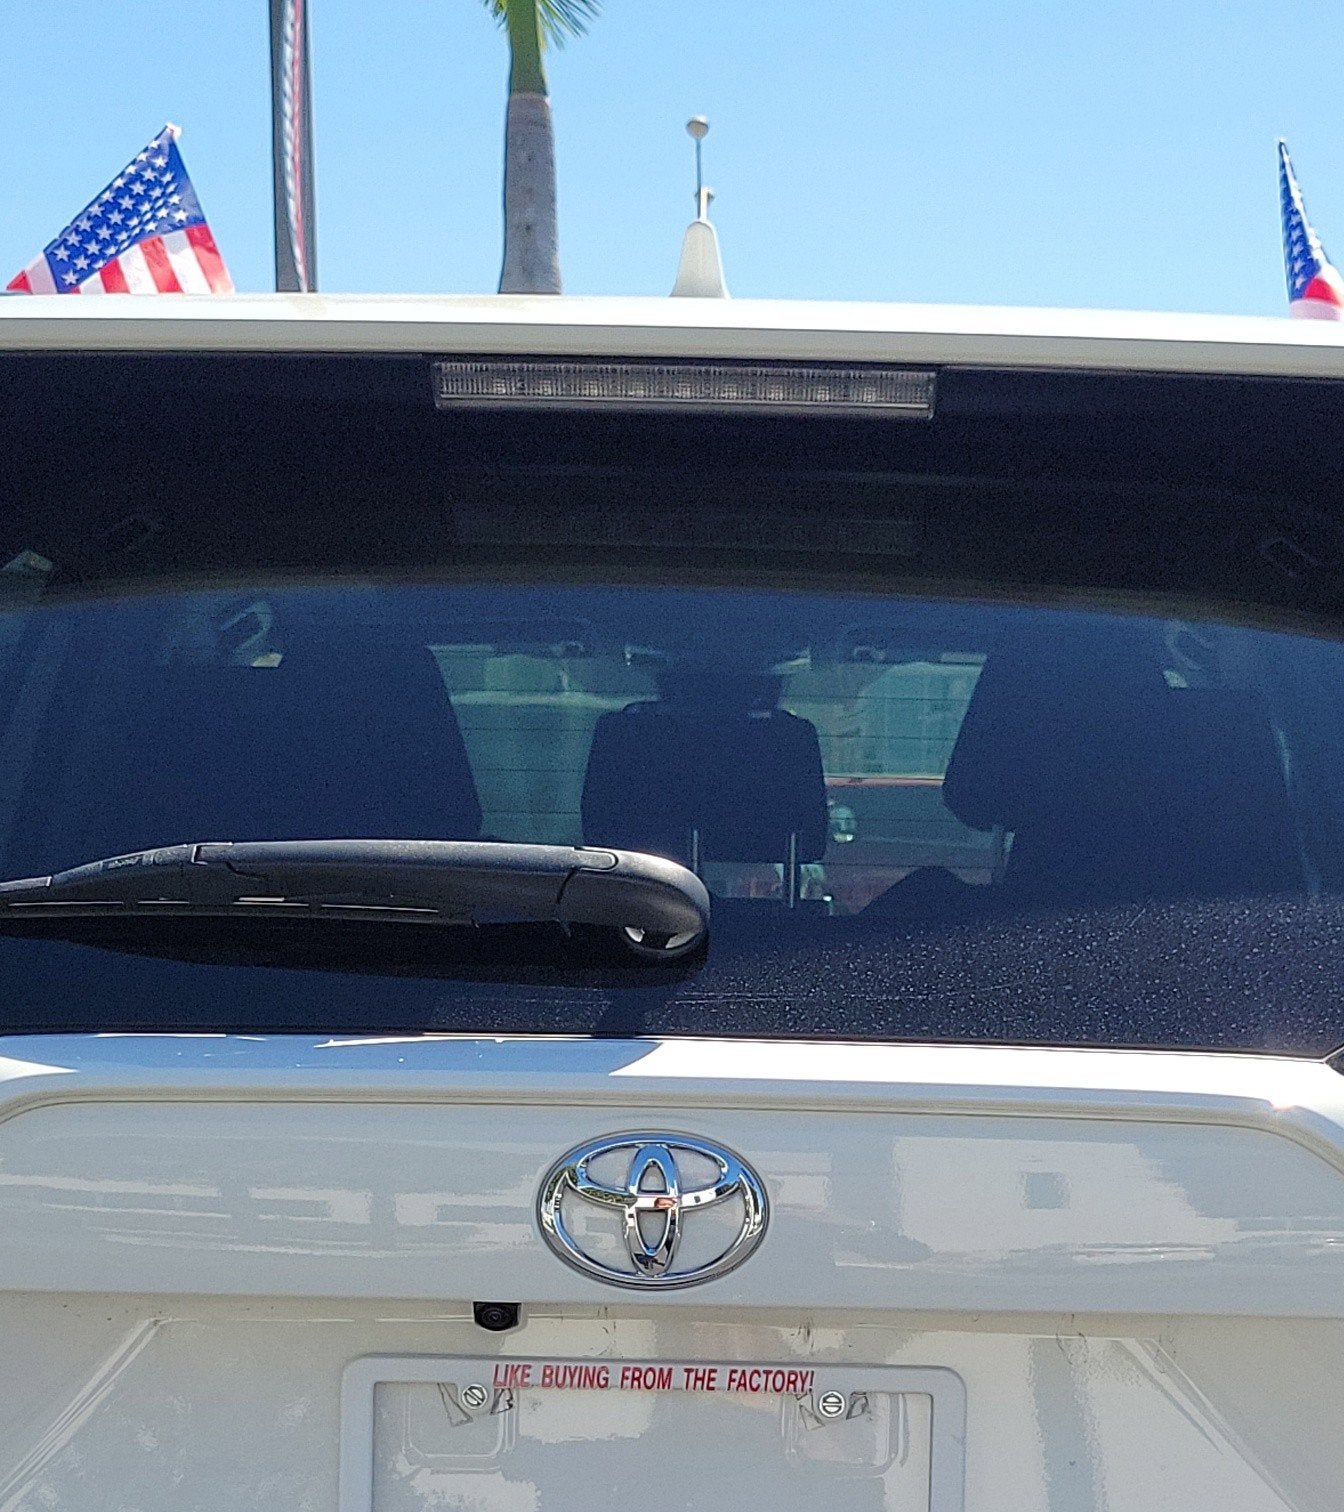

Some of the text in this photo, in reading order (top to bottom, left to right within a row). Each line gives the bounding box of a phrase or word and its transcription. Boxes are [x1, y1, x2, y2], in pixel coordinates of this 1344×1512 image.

[493, 1364, 815, 1393] LIKE BUYING FROM THE FACTORY!
